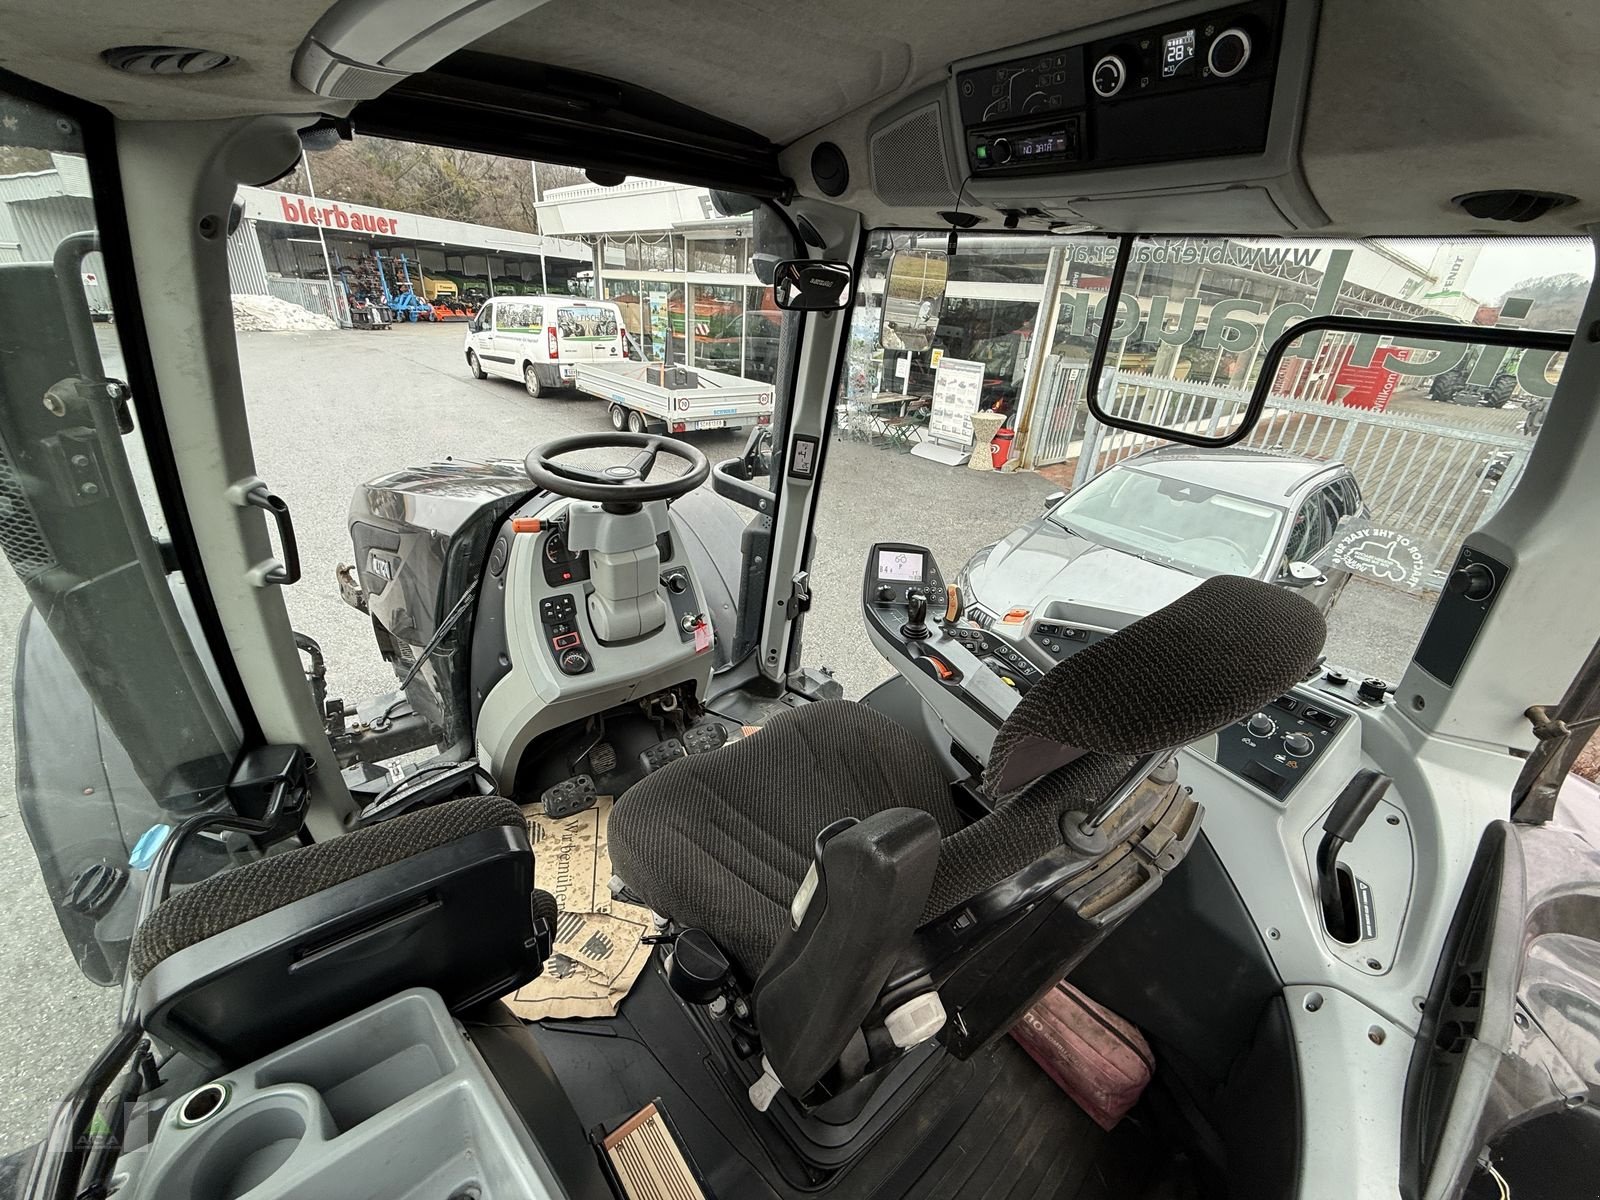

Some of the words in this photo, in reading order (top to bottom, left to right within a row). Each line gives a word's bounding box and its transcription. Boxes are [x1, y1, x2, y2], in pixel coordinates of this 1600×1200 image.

[1167, 45, 1184, 62] 28
[1023, 146, 1032, 155] NO
[1035, 142, 1052, 153] DATA
[280, 196, 398, 235] bierbauer
[1442, 255, 1465, 293] FENDT
[562, 820, 579, 842] Wir
